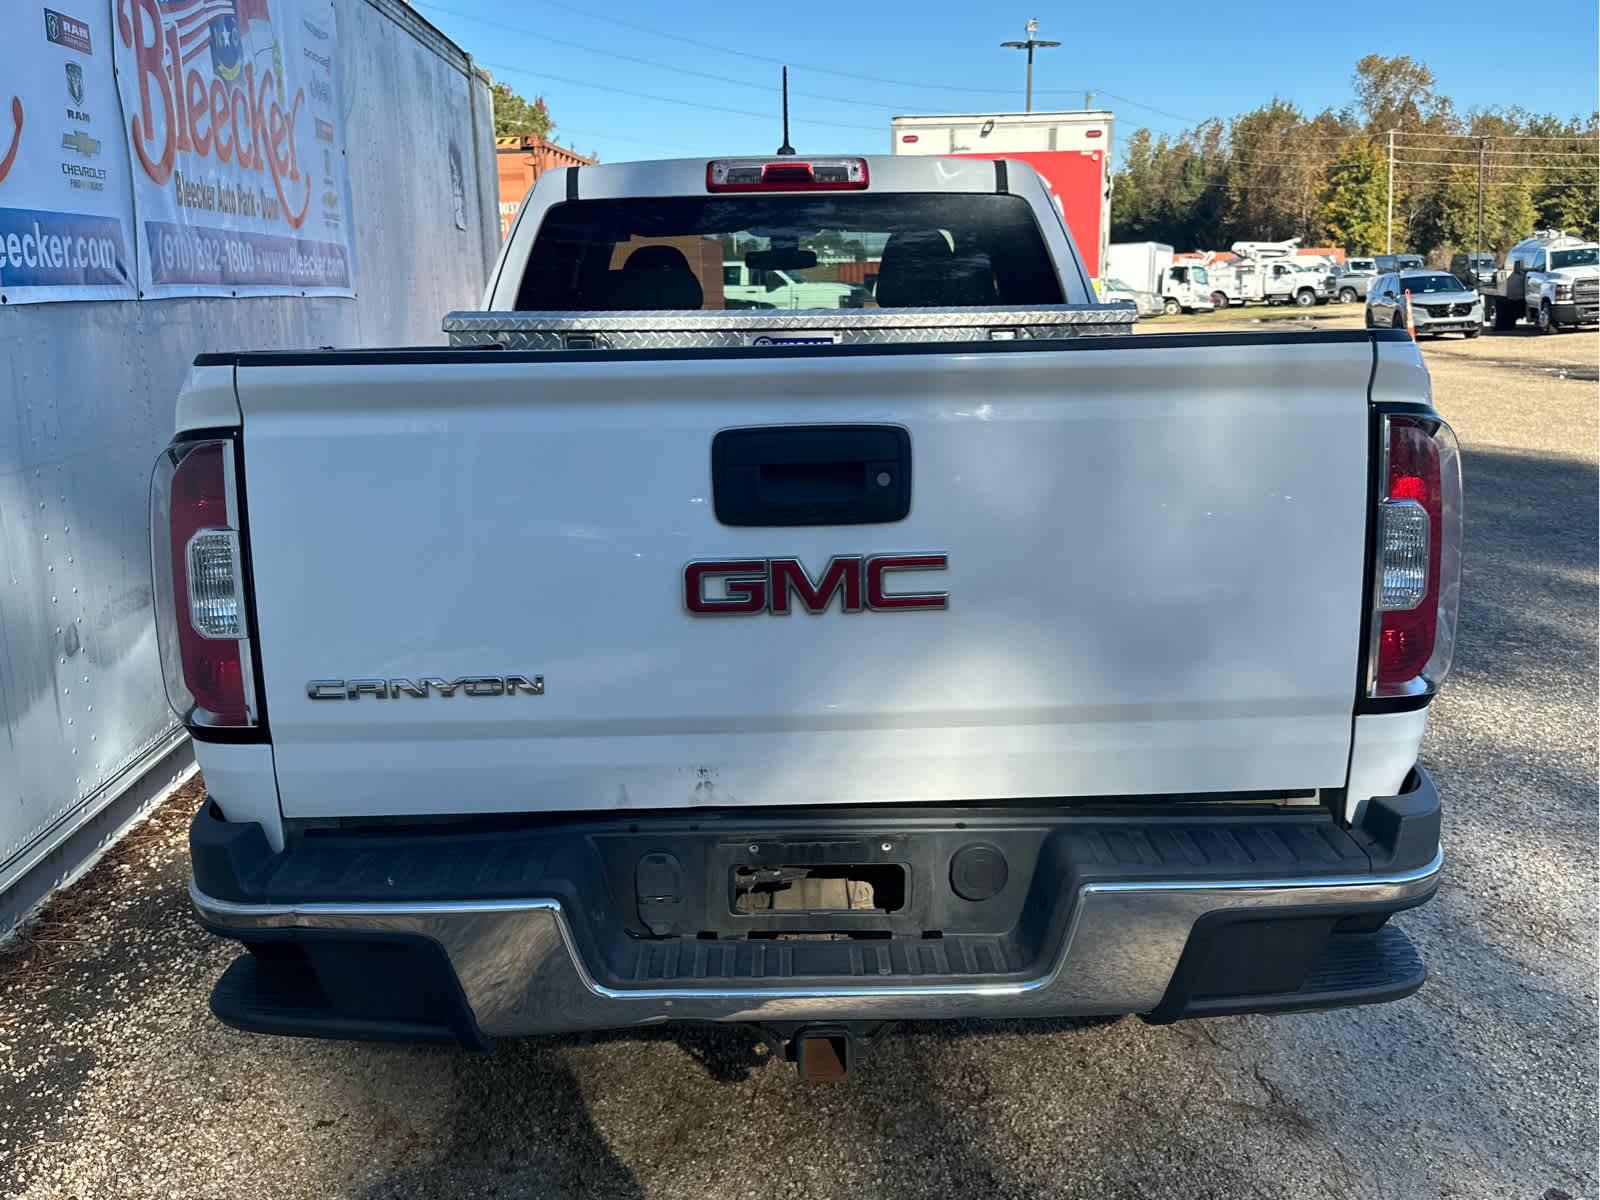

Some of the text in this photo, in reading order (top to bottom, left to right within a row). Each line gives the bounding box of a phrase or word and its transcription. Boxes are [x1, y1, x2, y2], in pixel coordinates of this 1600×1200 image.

[62, 20, 89, 40] RAM
[66, 108, 90, 122] RAM
[117, 0, 309, 229] Bleecker
[61, 162, 106, 180] CHEVROLET
[174, 170, 215, 211] Bleecker
[217, 178, 236, 214] Auto
[159, 228, 194, 279] (910)
[681, 551, 949, 616] GMC
[305, 674, 545, 701] CANYON
